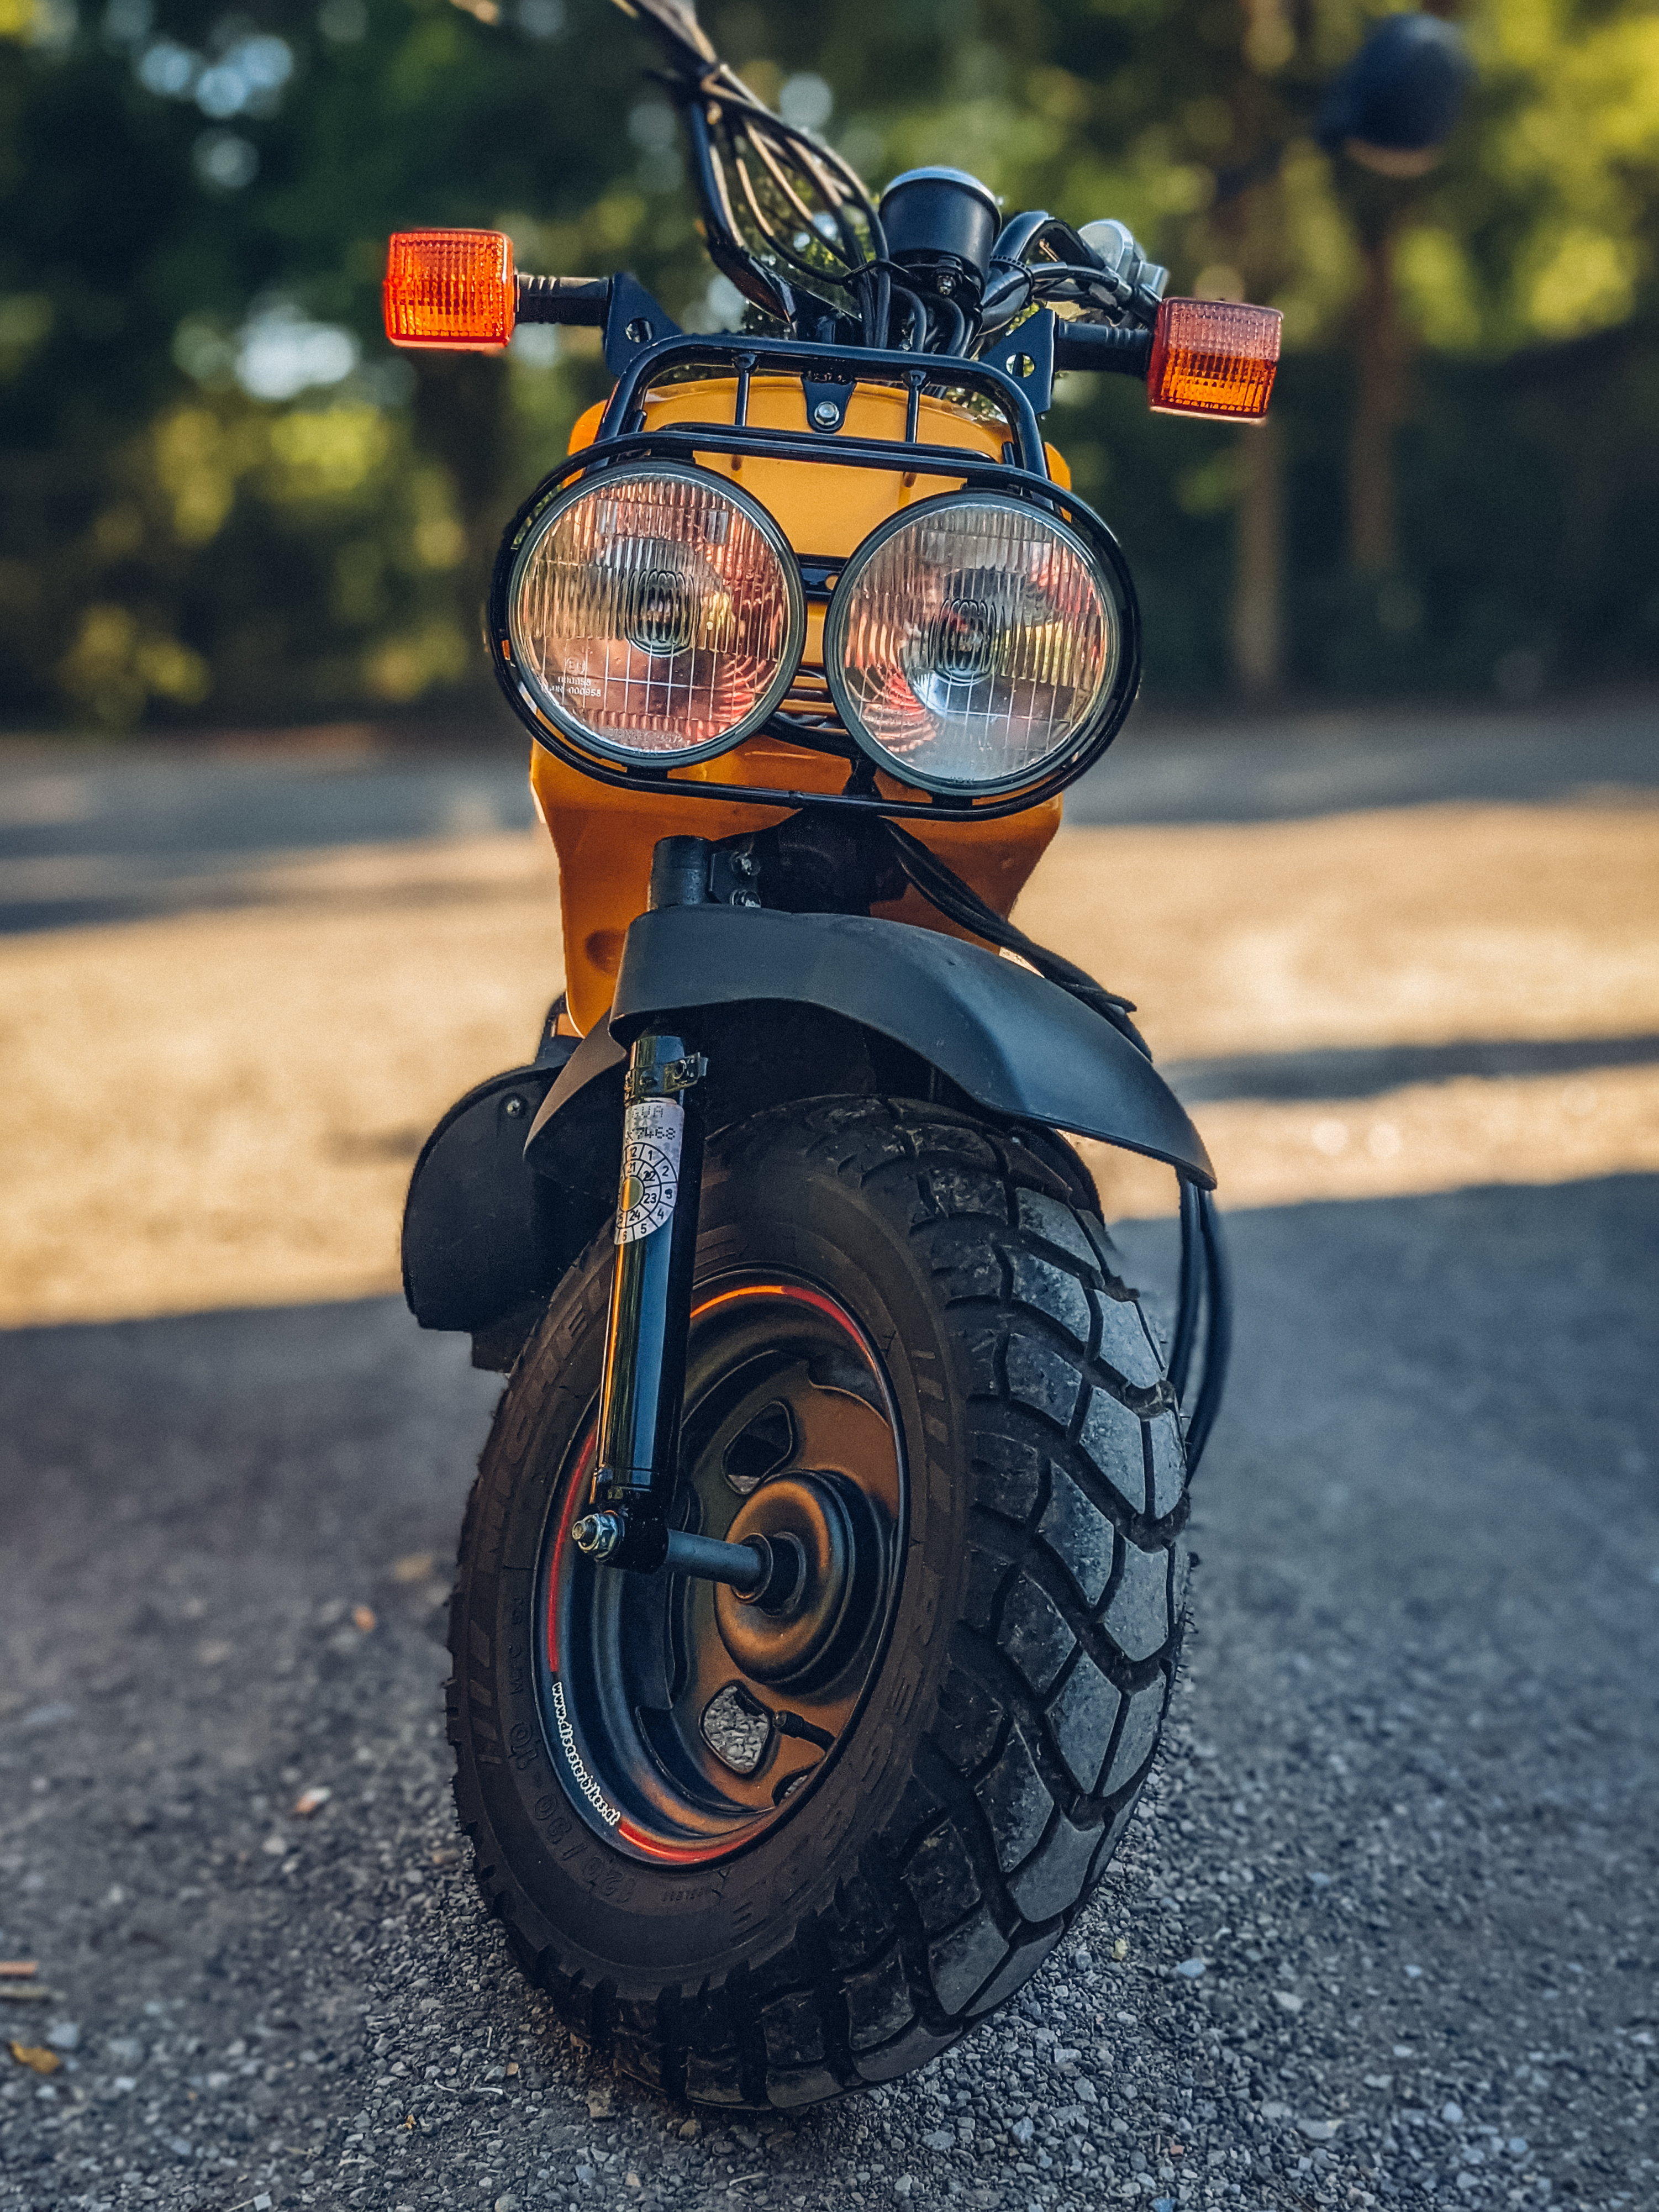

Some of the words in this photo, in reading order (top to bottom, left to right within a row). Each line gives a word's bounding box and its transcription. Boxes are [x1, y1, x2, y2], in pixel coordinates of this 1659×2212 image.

[647, 1150, 653, 1161] 1
[643, 1170, 656, 1182] 22
[662, 1166, 669, 1177] 2
[643, 1193, 657, 1204] 23
[629, 1209, 641, 1221] 24
[657, 1208, 664, 1220] 4
[640, 1223, 647, 1234] 5
[552, 1682, 621, 1825] www.disasterbikes.at
